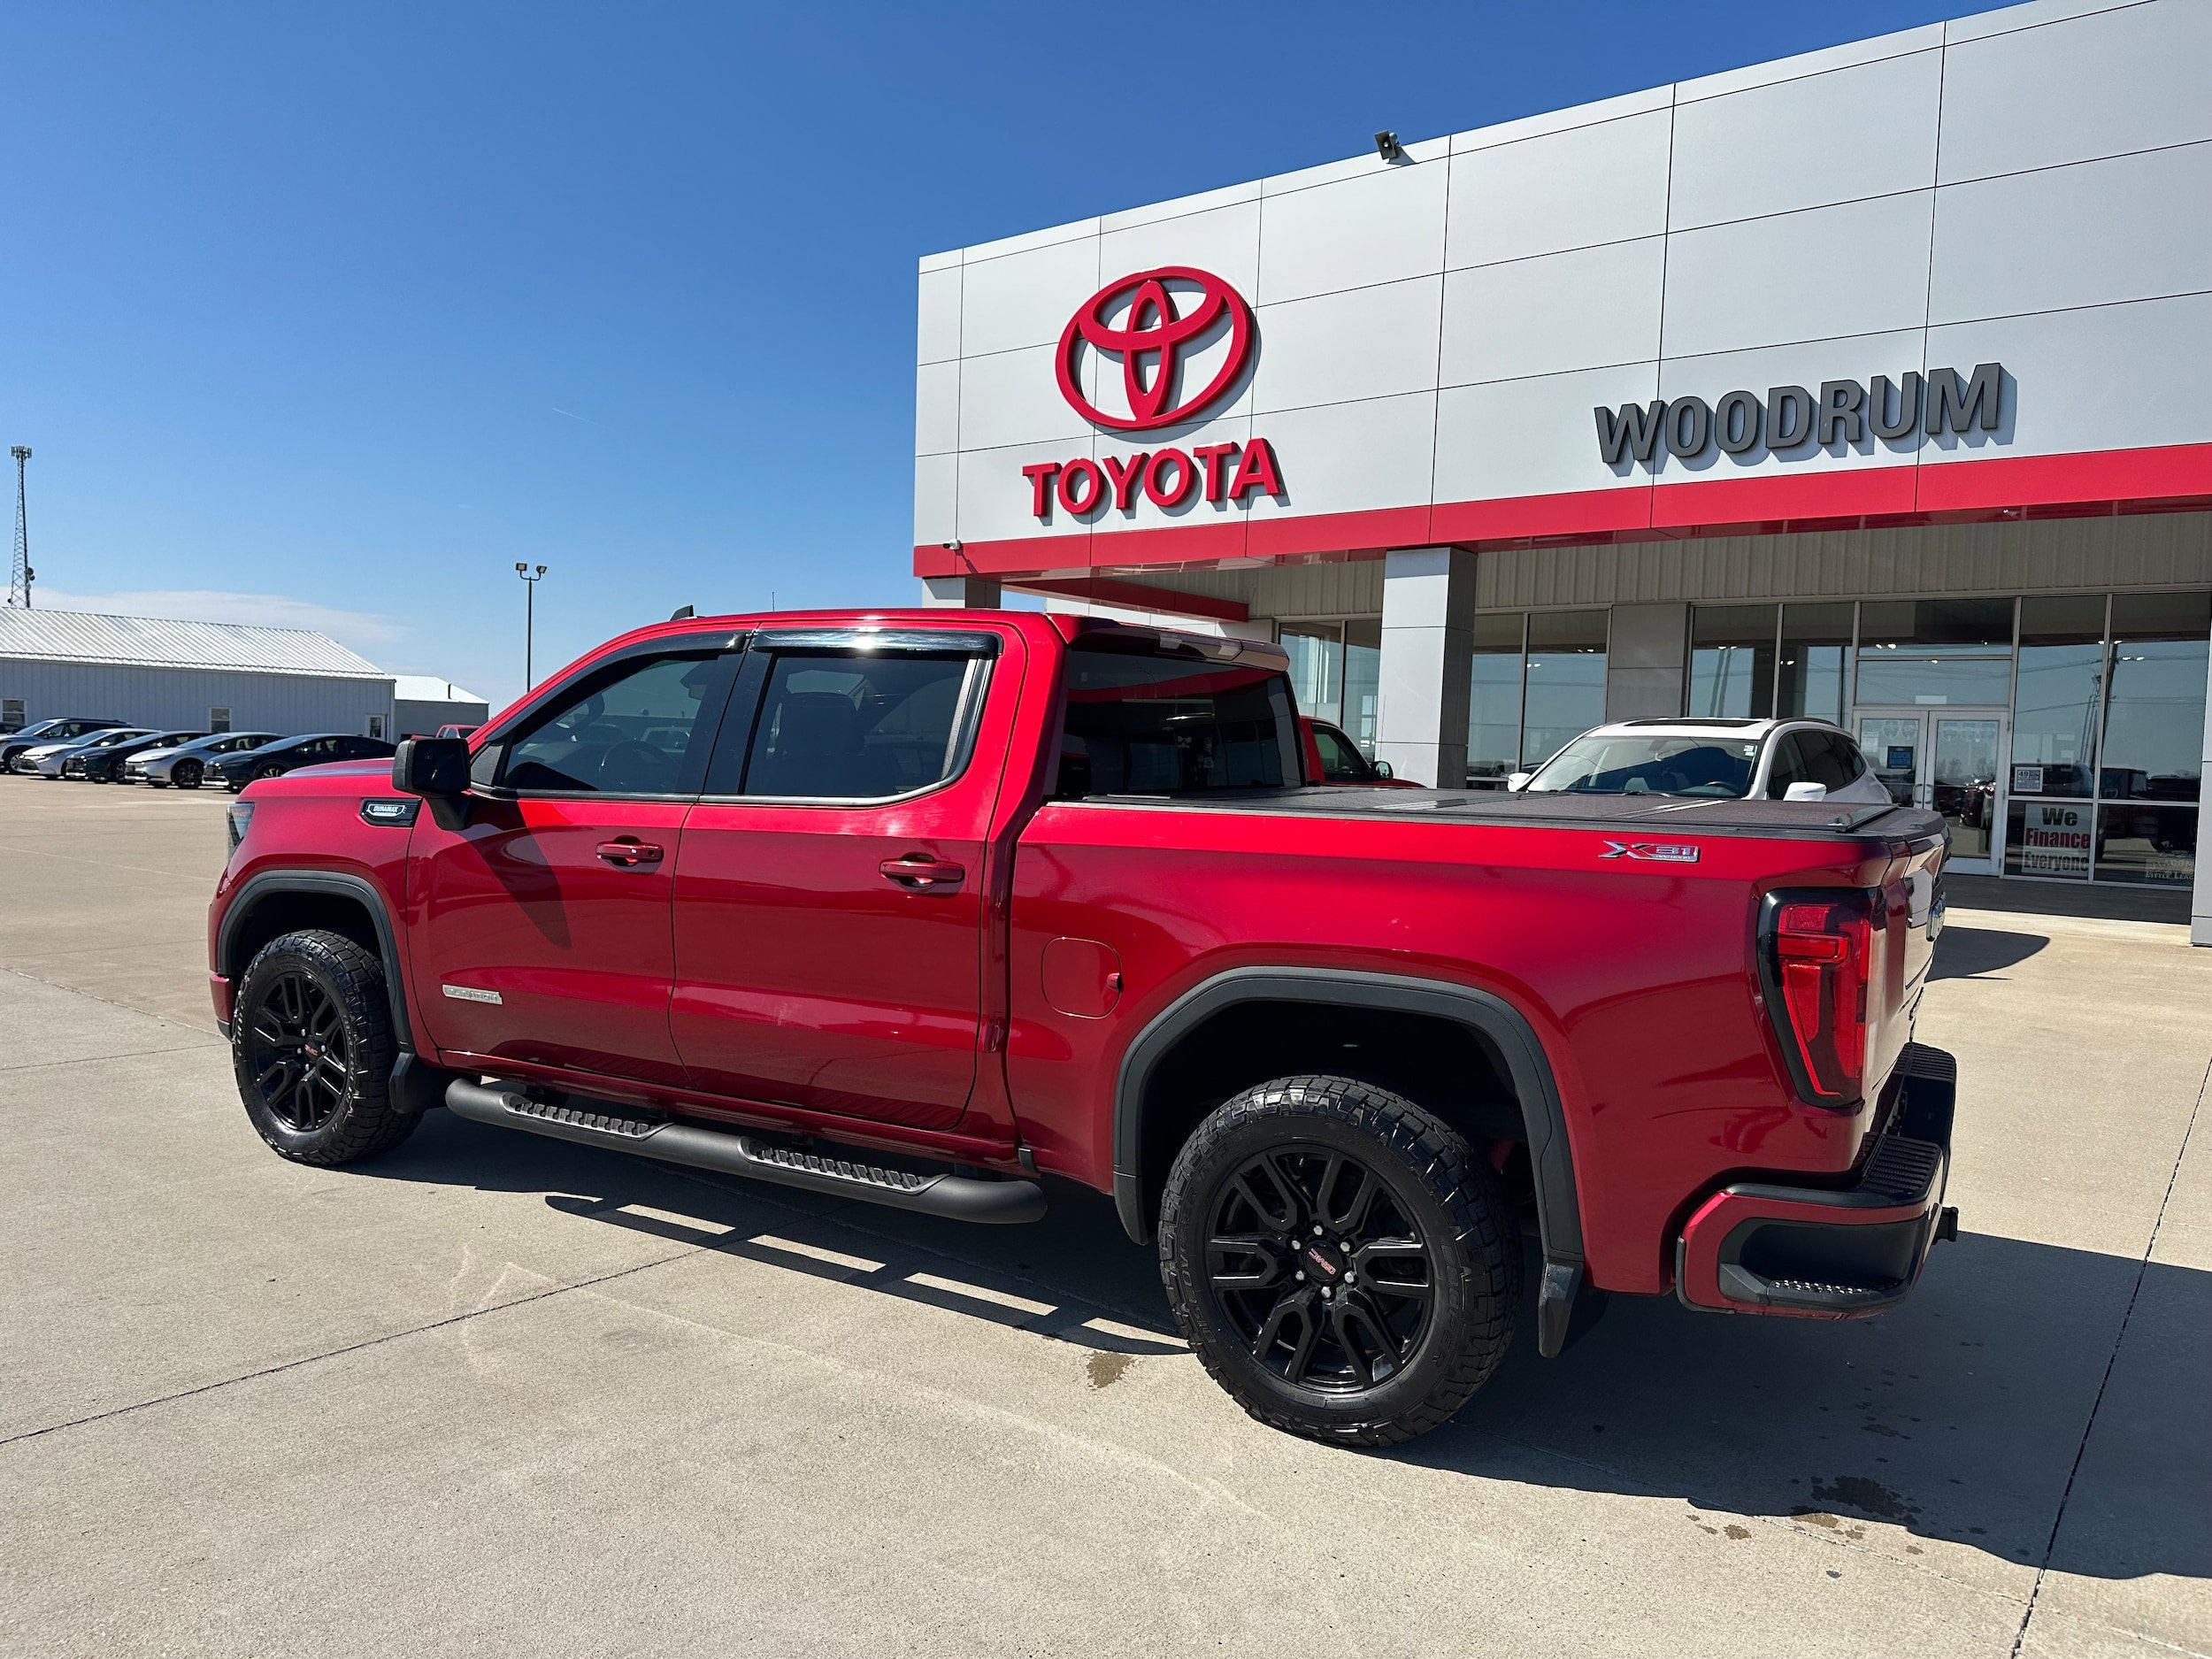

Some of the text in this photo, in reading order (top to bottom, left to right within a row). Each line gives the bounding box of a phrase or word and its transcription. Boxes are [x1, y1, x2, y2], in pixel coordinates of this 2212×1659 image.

[1594, 363, 2001, 464] WOODRUM
[1023, 437, 1281, 517] TOYOTA
[373, 804, 398, 813] DURAMAX
[2042, 808, 2078, 826] We
[2025, 828, 2091, 849] Finance
[2024, 851, 2089, 872] Everyone
[1309, 1248, 1336, 1274] GMC
